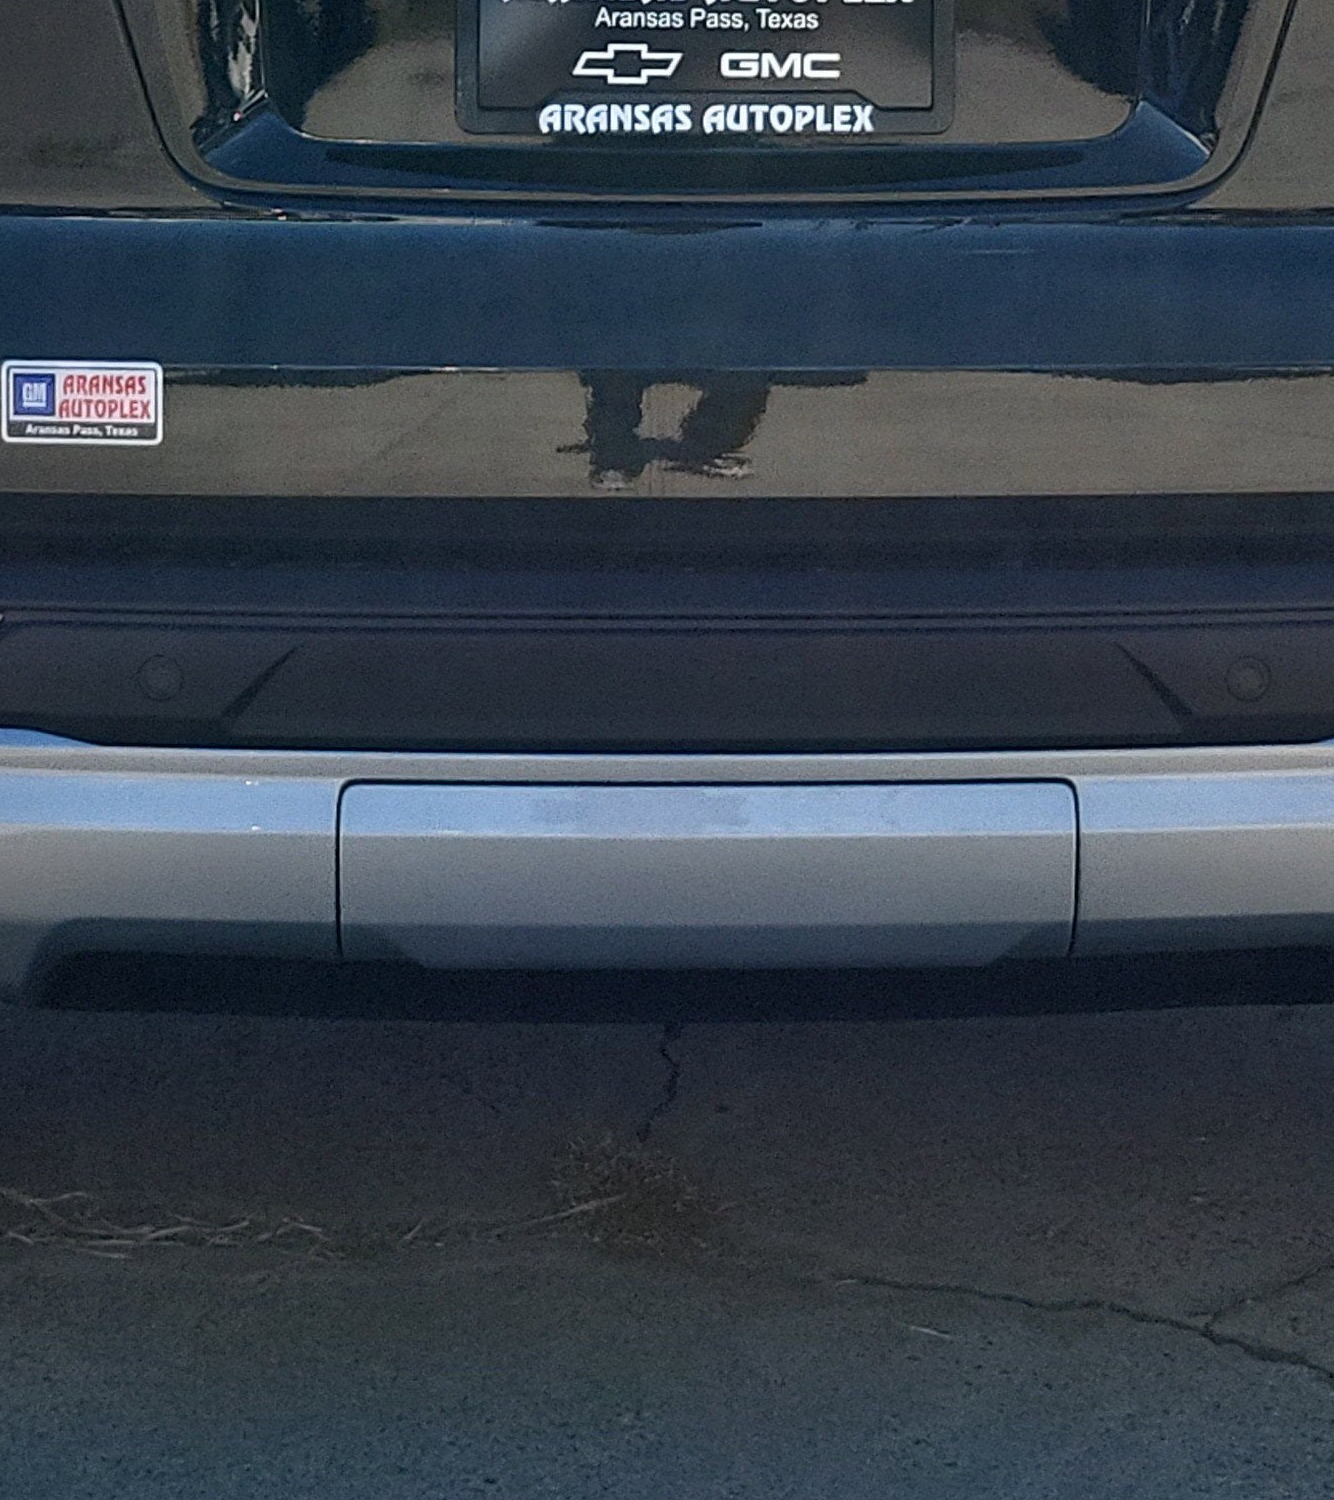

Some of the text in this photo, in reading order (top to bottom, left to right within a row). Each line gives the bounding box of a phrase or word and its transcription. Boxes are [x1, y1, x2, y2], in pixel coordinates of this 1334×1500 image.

[594, 8, 820, 32] Aransas Pass, Texas
[719, 52, 842, 79] GMC
[538, 103, 875, 135] ARANSAS AUTOPLEX
[22, 382, 48, 403] GM
[62, 374, 147, 397] ARANSAS
[58, 399, 152, 420] AUTOPLEX
